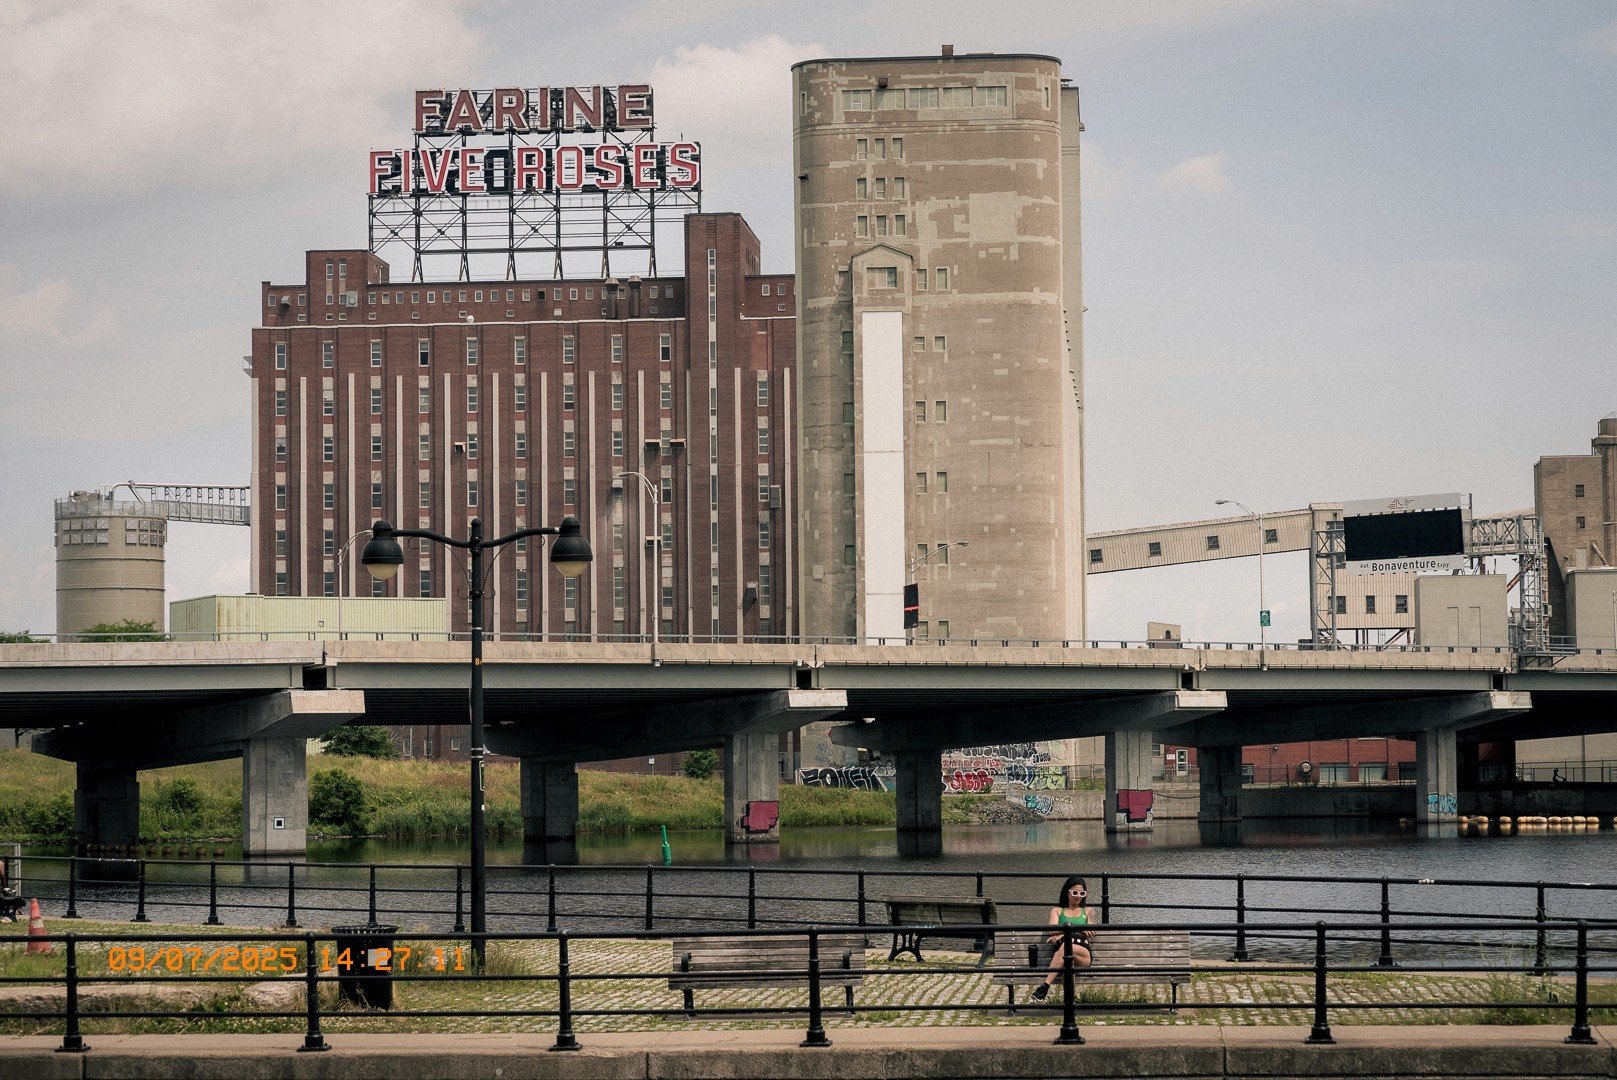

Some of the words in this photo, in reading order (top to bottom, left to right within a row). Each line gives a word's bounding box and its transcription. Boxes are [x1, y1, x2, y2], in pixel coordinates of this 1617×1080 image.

[414, 85, 653, 132] FARINE
[368, 147, 486, 194] FIVE
[514, 142, 700, 192] ROSES
[1371, 560, 1436, 572] Bonaventure
